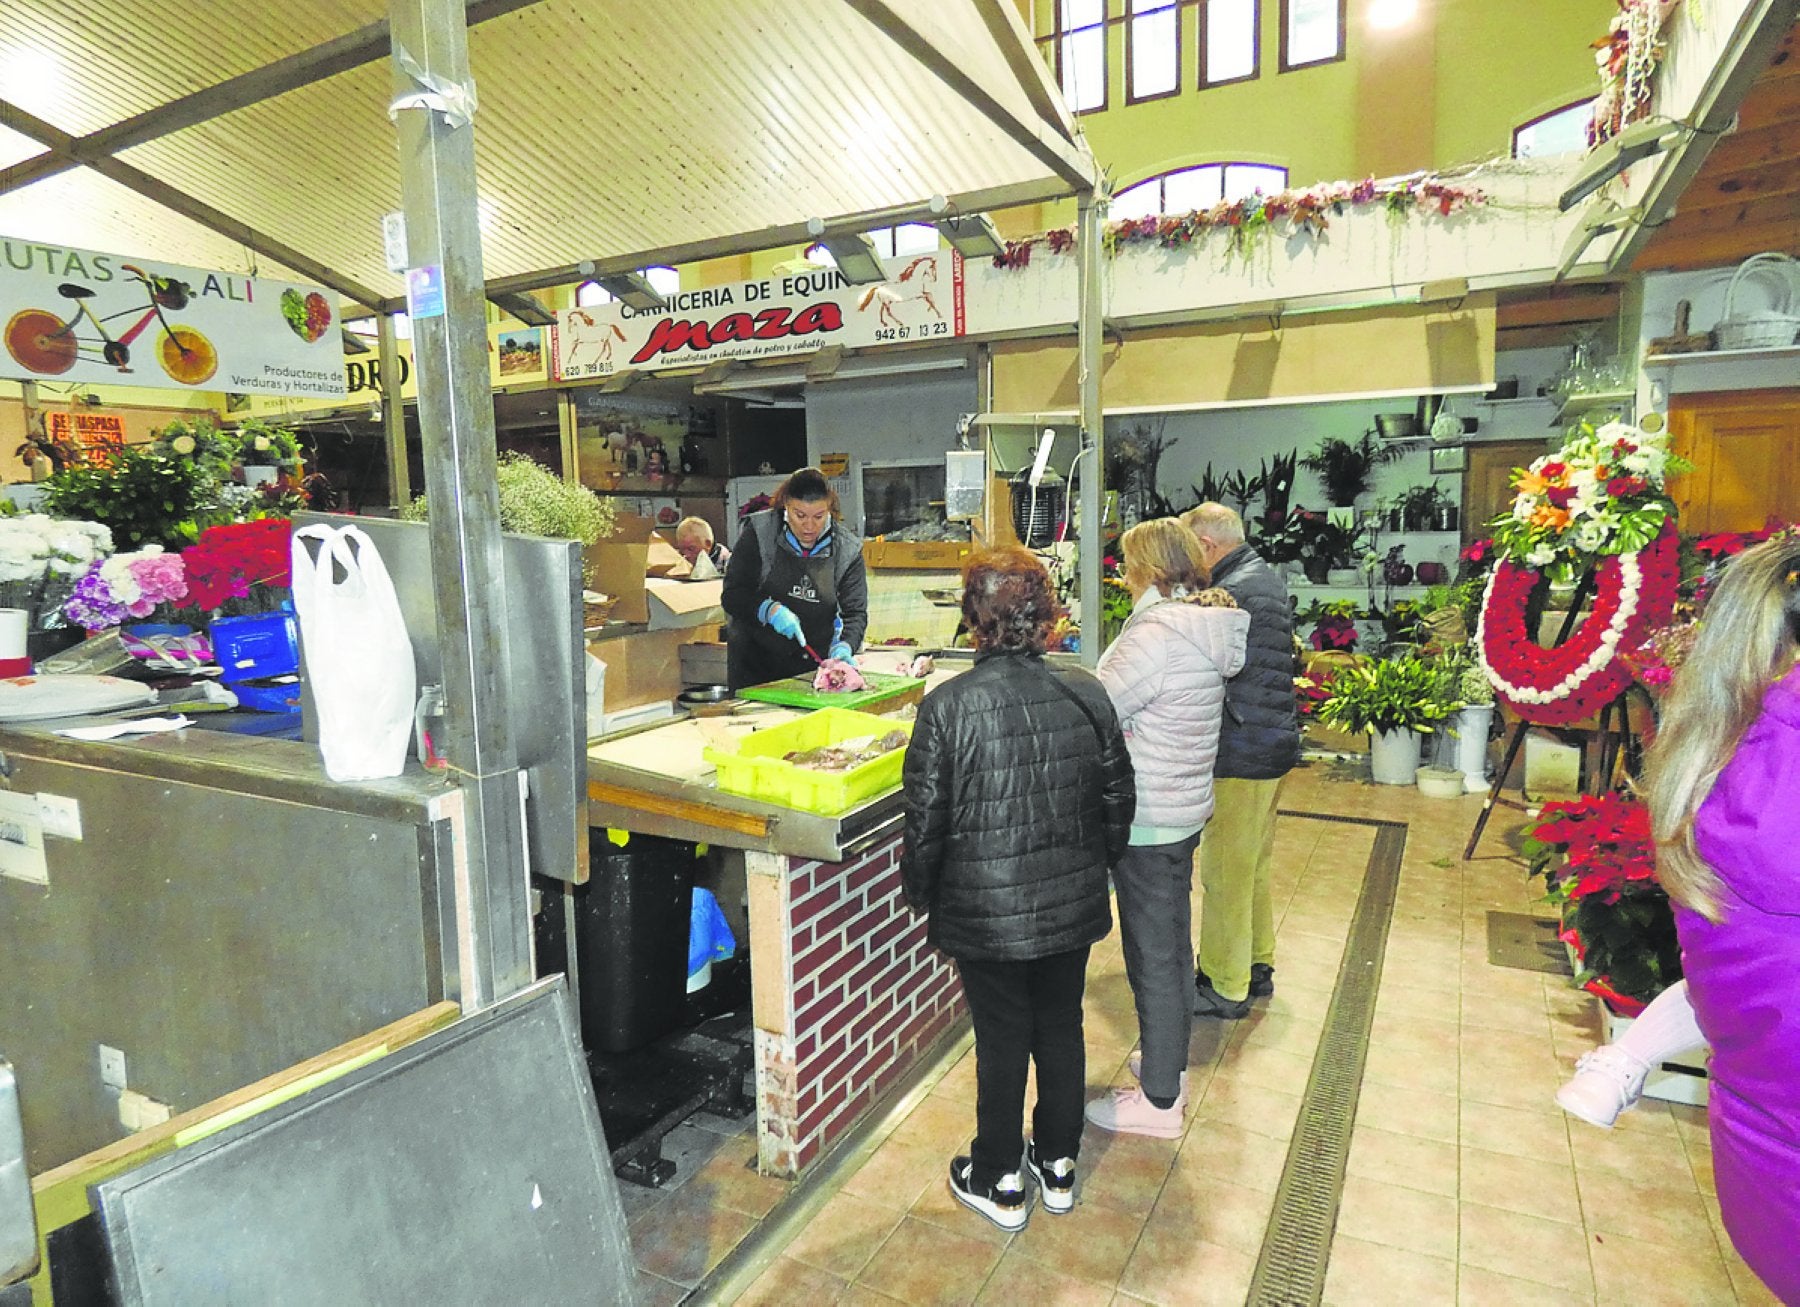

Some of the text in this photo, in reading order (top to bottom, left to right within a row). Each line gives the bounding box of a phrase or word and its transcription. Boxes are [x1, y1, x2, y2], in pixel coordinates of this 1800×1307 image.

[0, 242, 253, 303] UTAS ALI
[745, 281, 771, 302] DE
[782, 271, 865, 297] EQUIN
[875, 322, 948, 341] 942 67 13 23
[753, 344, 762, 354] de
[264, 365, 343, 382] Productores de
[231, 375, 344, 394] Verduras y Hortalizas
